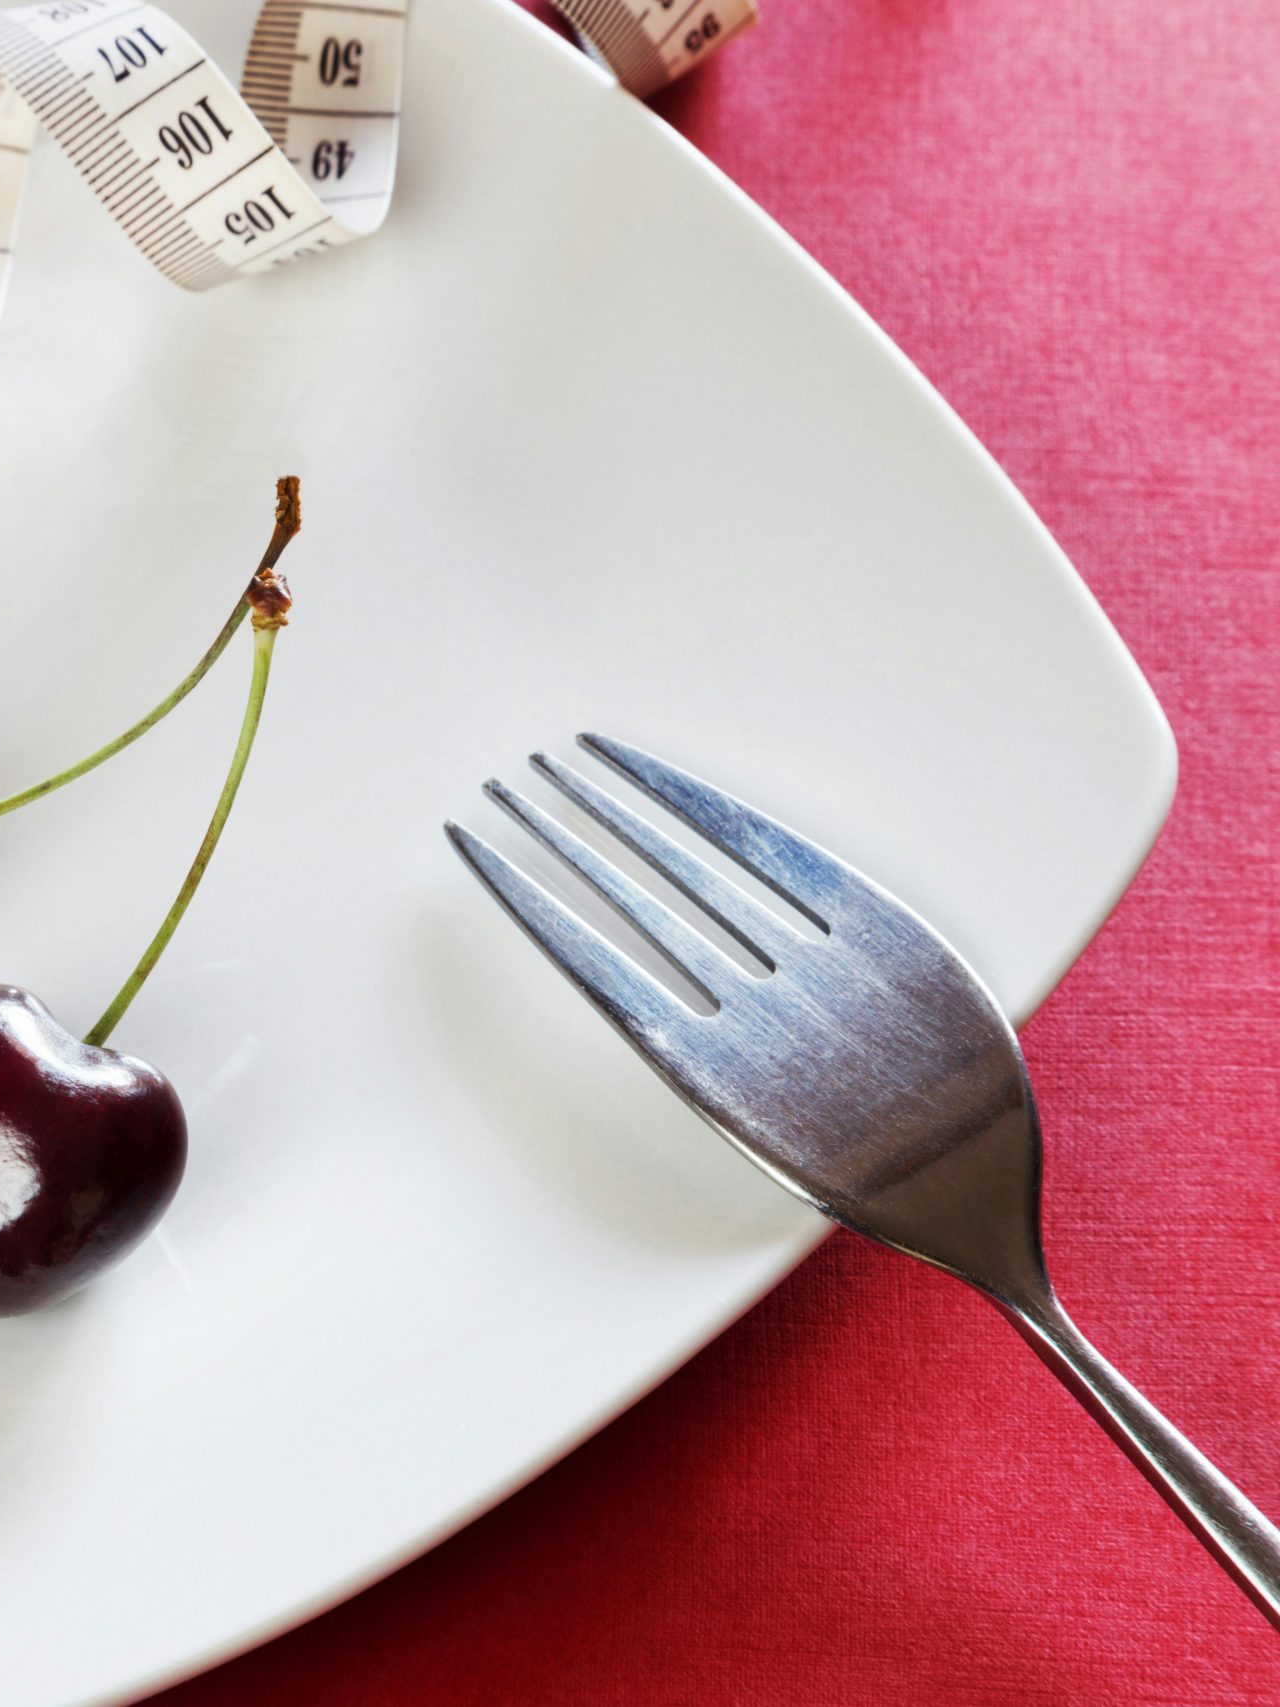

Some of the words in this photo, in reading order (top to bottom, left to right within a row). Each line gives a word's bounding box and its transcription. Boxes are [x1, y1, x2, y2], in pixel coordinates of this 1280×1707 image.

[97, 26, 168, 83] 107
[320, 37, 362, 88] 50
[158, 96, 233, 170] 106
[311, 140, 354, 182] 49
[225, 185, 295, 245] 105
